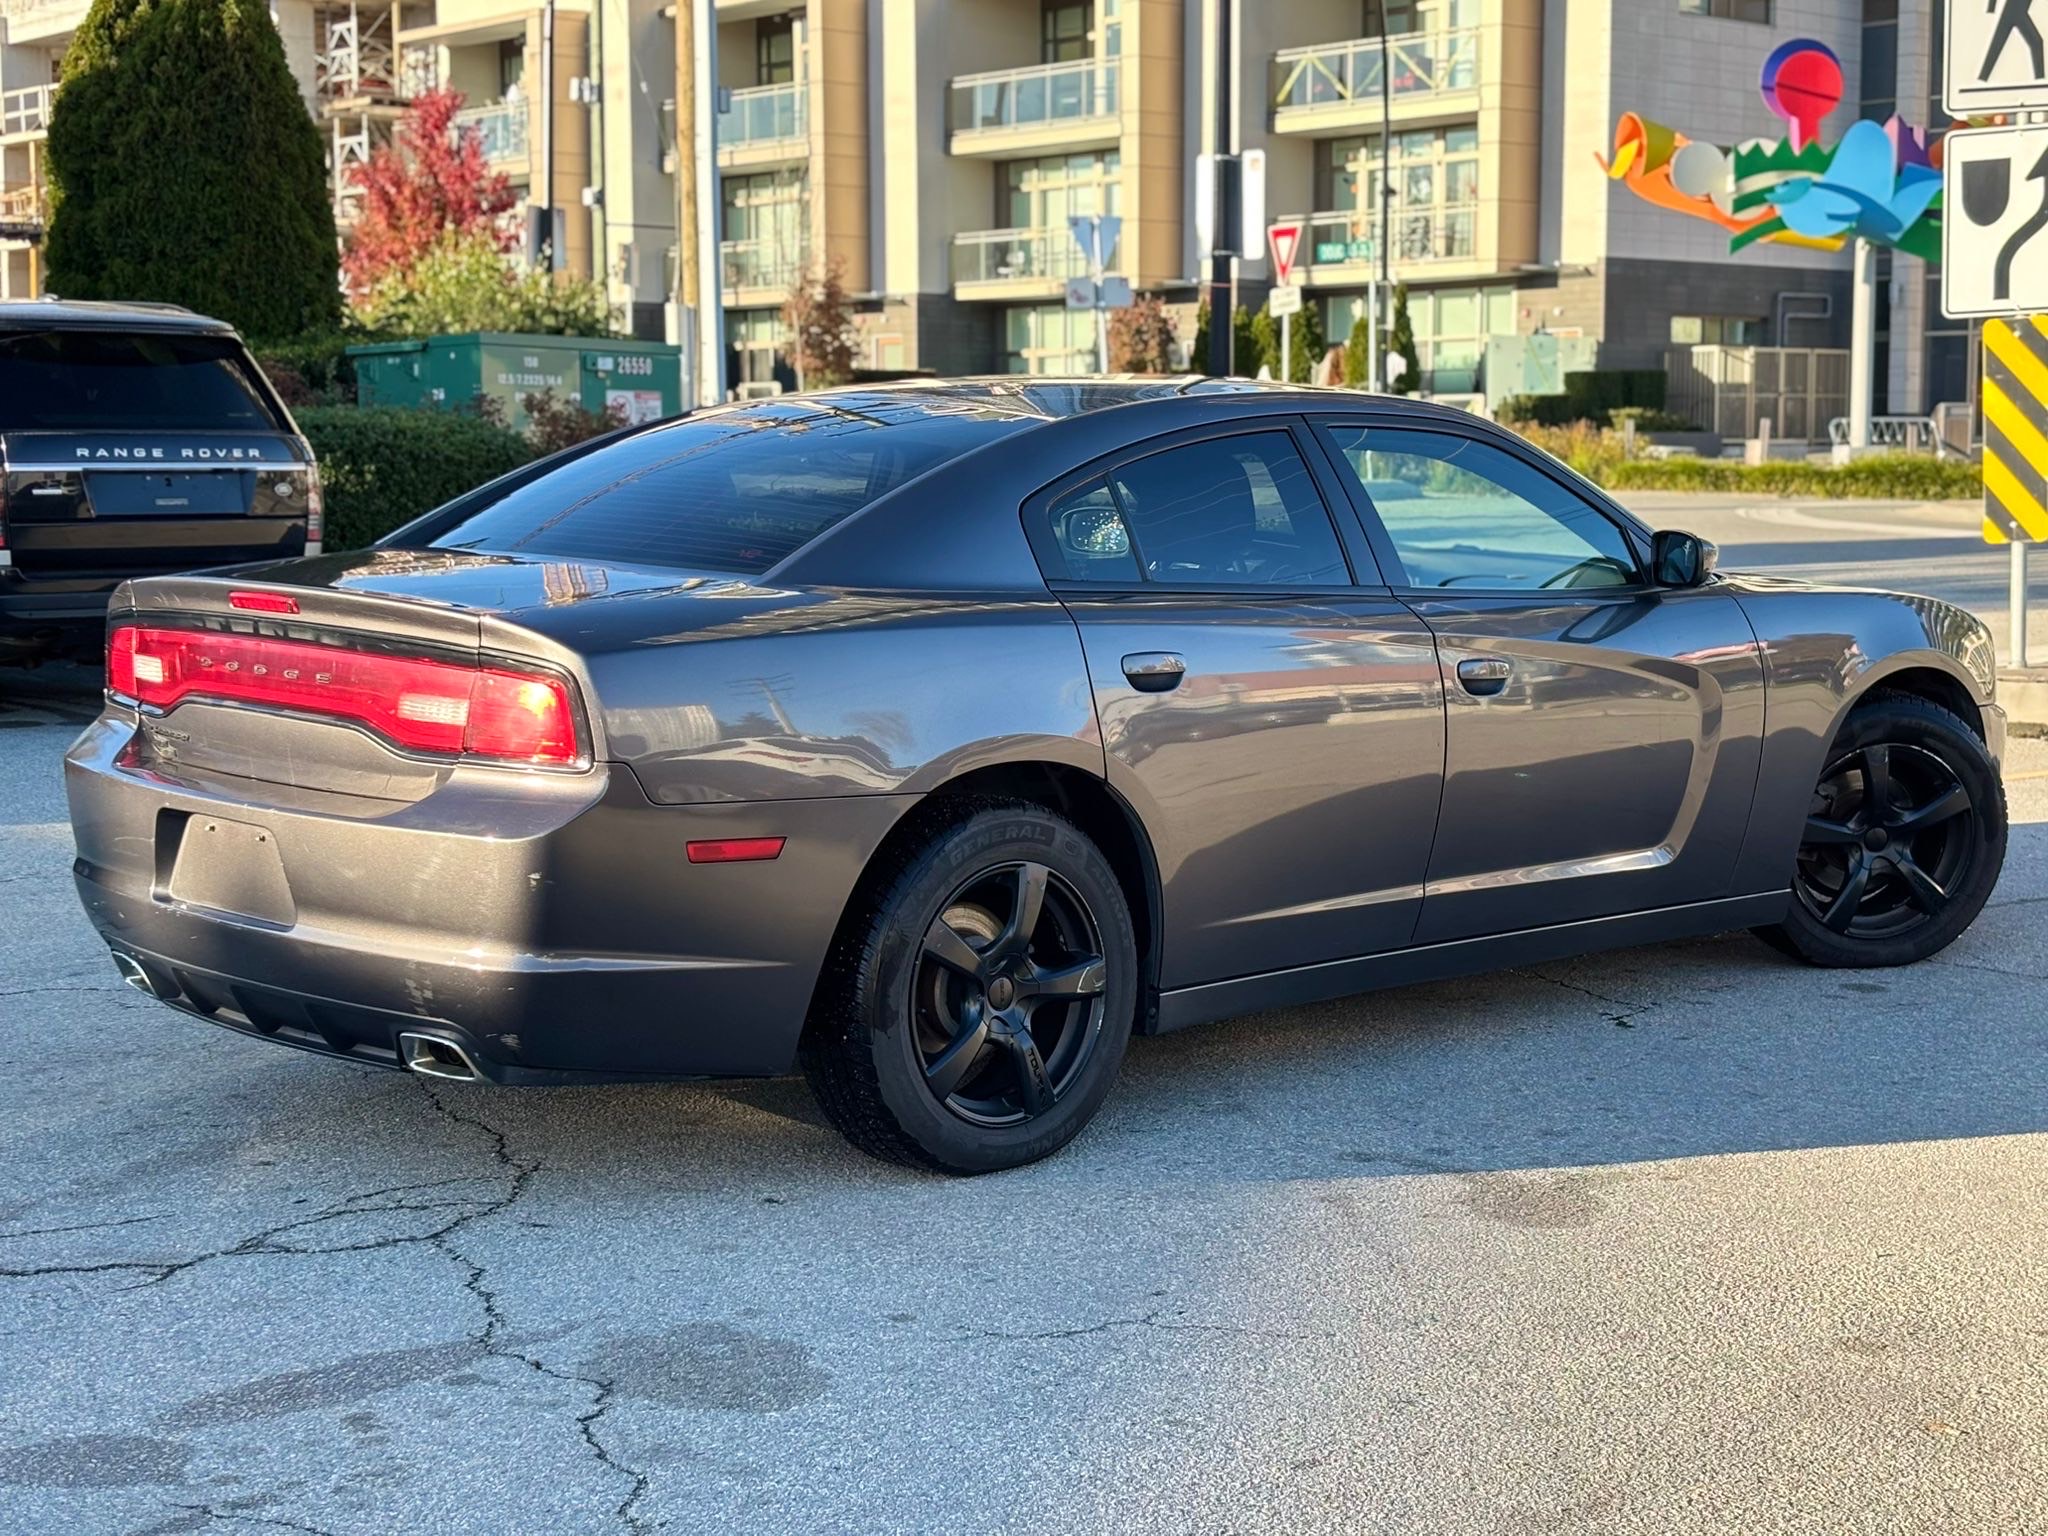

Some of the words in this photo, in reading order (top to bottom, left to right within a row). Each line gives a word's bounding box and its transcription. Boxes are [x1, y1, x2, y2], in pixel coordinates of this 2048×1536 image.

[617, 356, 653, 375] 26550
[76, 447, 164, 458] RANGE
[181, 448, 261, 458] ROVER
[199, 656, 332, 685] DODGE
[948, 824, 1047, 867] GENERAL
